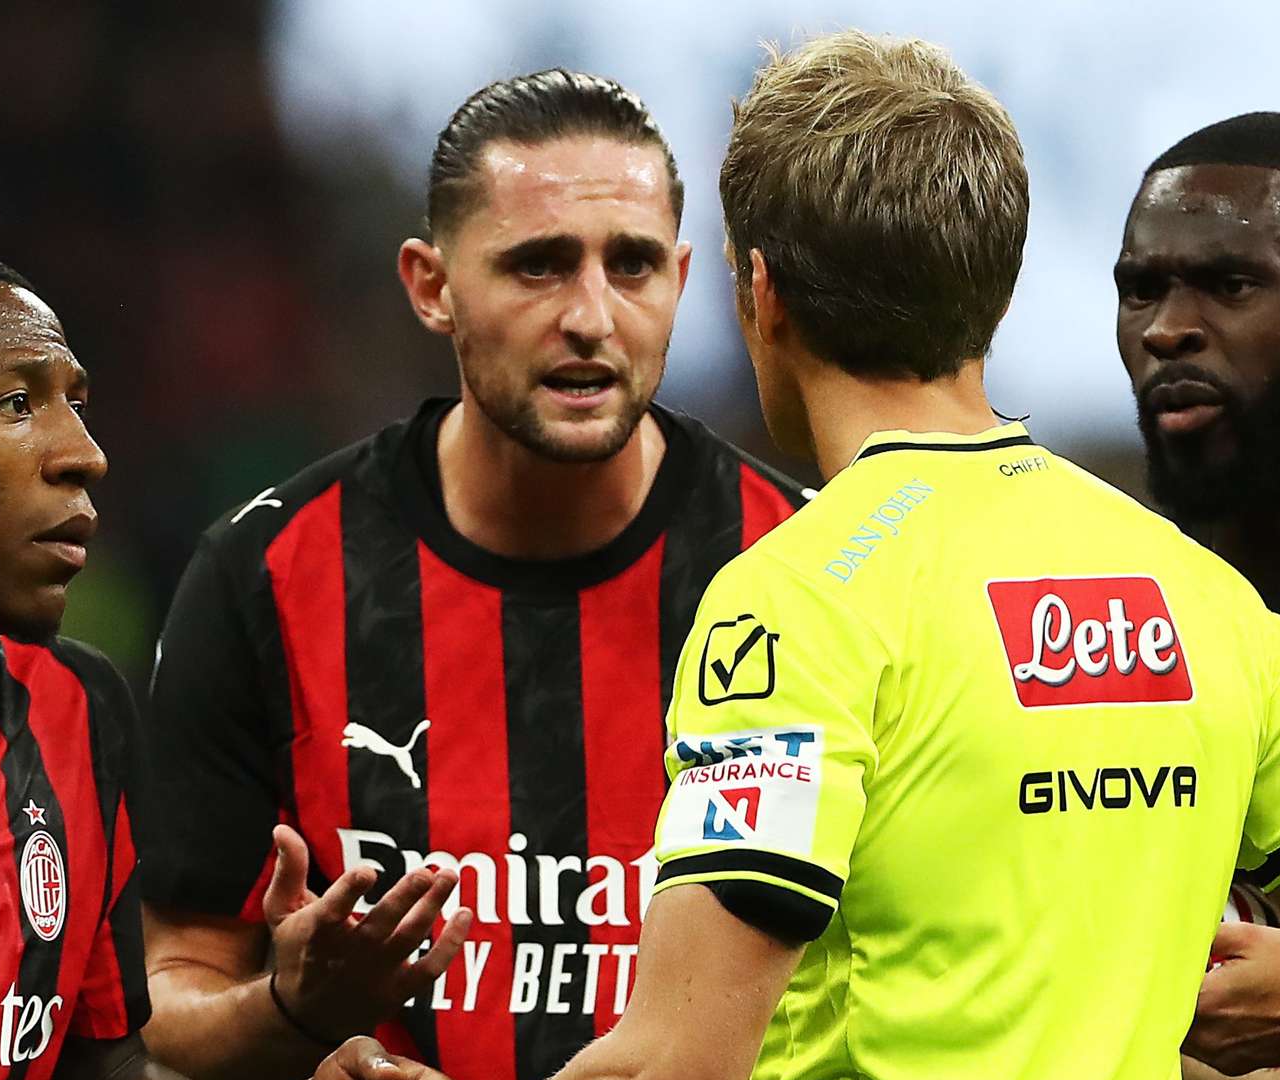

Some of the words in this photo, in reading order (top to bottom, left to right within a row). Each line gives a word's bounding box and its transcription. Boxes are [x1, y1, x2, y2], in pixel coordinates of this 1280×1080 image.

[999, 457, 1049, 477] CHIFFI
[825, 524, 883, 583] DAN
[869, 478, 934, 536] JOHN
[1014, 593, 1178, 687] Lete
[680, 762, 812, 786] INSURANCE
[1019, 766, 1197, 814] GIVOVA
[337, 827, 661, 926] Emirat
[509, 942, 640, 1014] BETT
